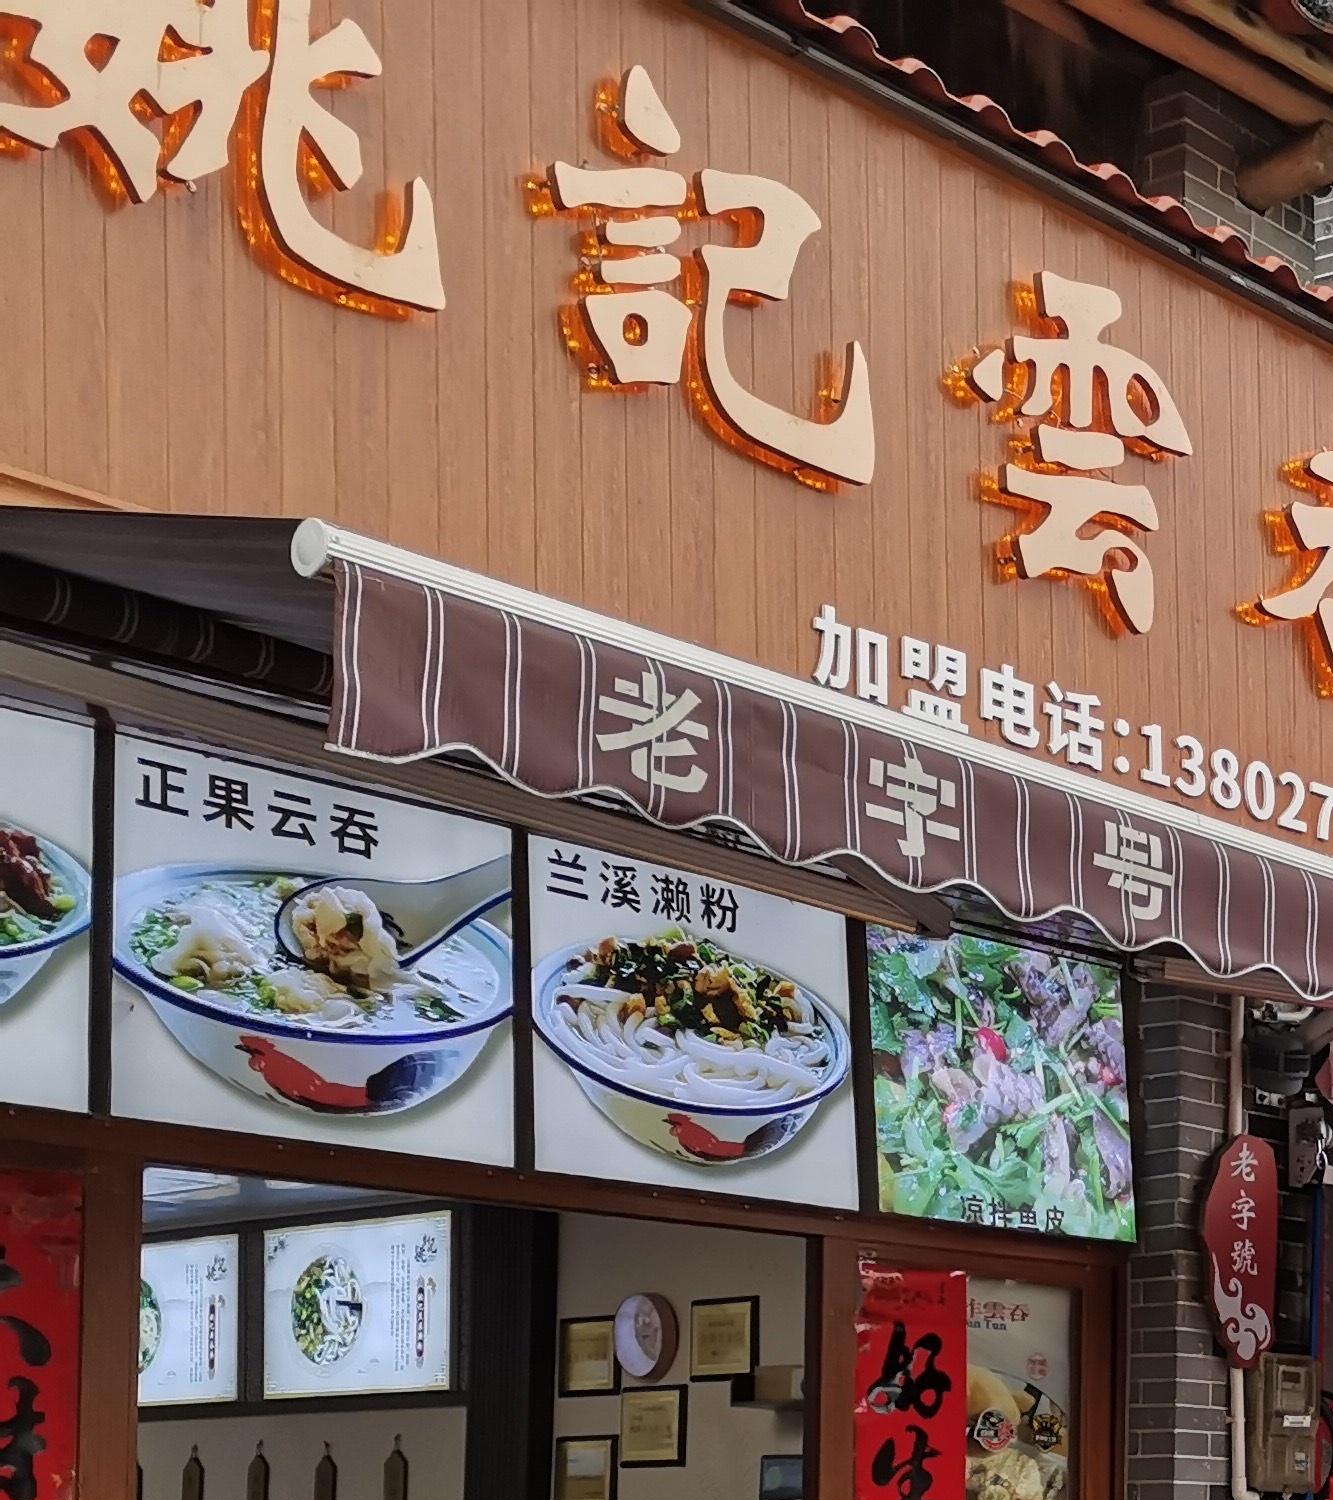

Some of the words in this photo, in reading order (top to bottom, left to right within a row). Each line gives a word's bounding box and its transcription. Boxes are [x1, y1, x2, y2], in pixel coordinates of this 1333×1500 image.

[135, 757, 380, 860] 正果云吞
[546, 848, 740, 934] 兰溪濑粉
[959, 1194, 1066, 1236] 凉拌鱼皮
[1230, 1142, 1259, 1276] 老字號
